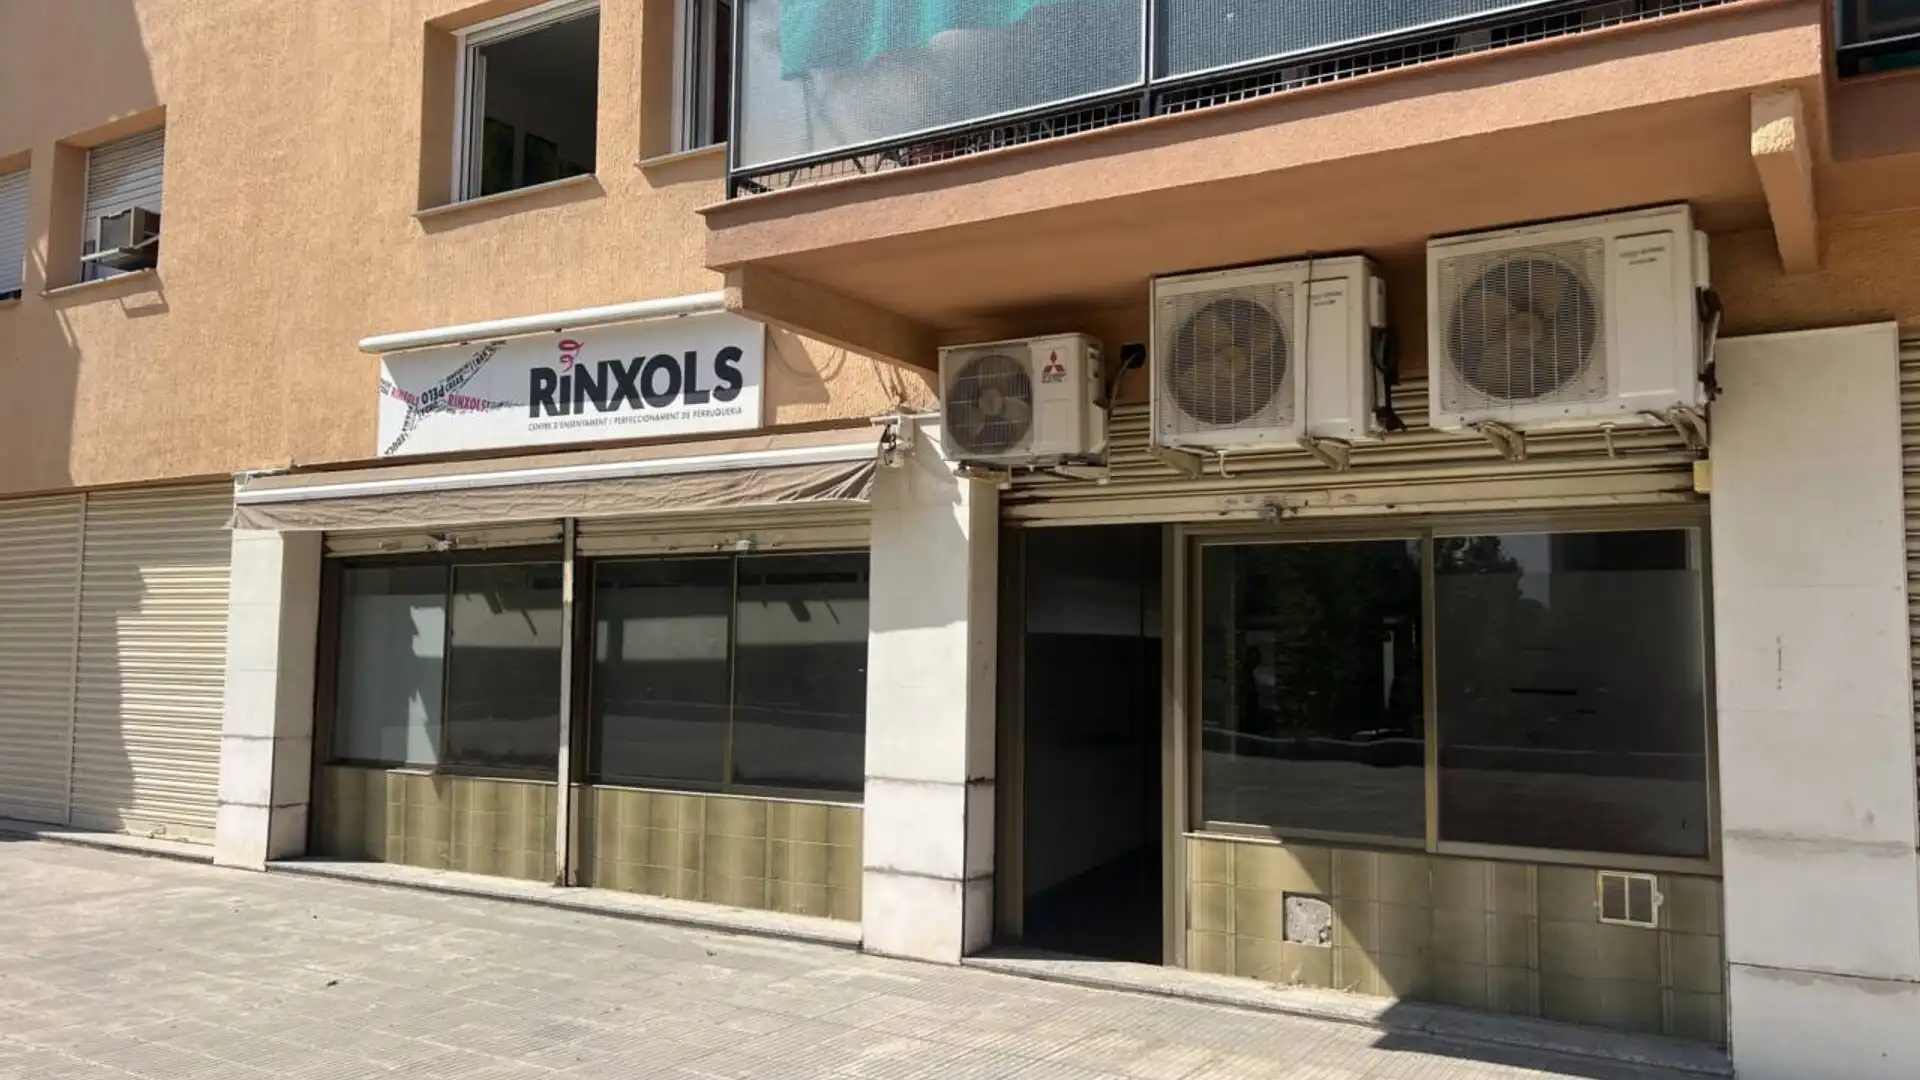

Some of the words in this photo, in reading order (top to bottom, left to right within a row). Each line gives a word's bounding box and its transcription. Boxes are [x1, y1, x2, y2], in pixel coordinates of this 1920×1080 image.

[528, 422, 551, 432] CENTRE
[613, 411, 680, 426] PERFECCIONAMENT
[681, 411, 690, 420] DE
[692, 406, 743, 419] PERRUQUERIA
